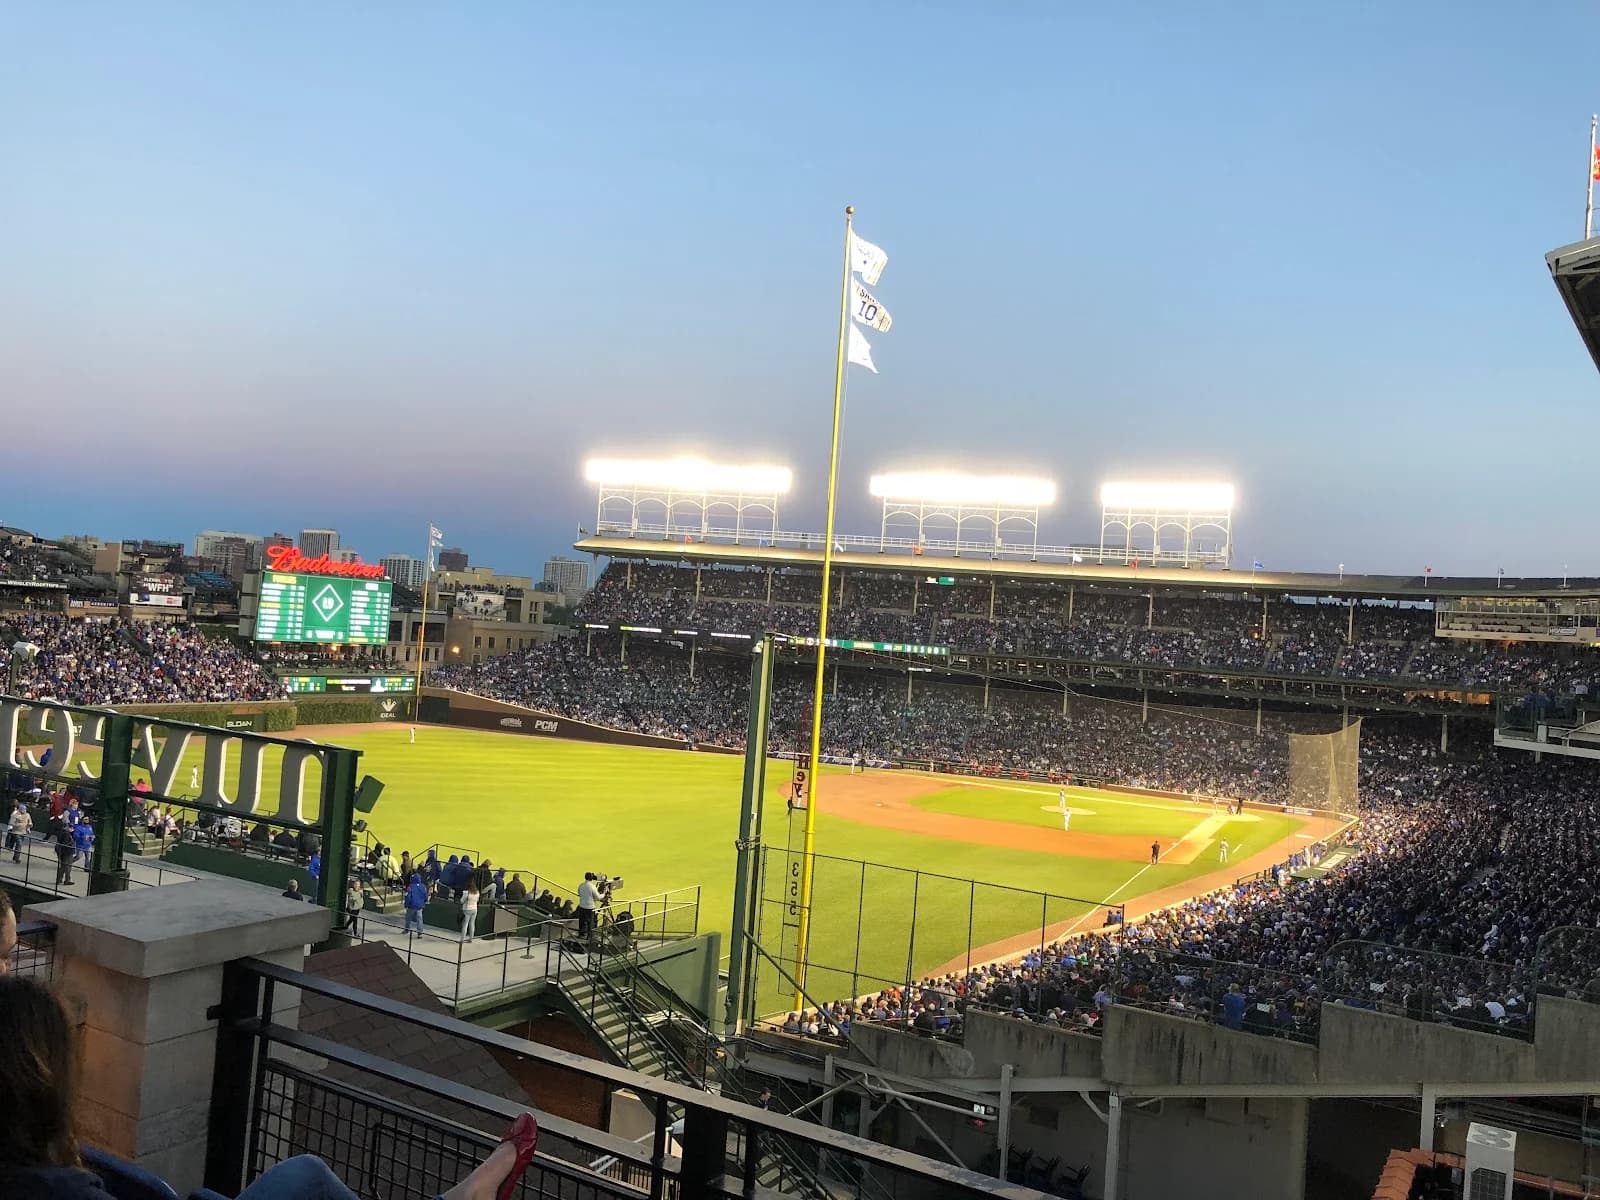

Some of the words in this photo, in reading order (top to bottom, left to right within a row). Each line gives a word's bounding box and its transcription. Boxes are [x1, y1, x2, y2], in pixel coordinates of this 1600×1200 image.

[858, 300, 877, 320] 10
[267, 545, 385, 578] Budweiser
[226, 720, 253, 728] SLOAN
[534, 719, 559, 733] PCM
